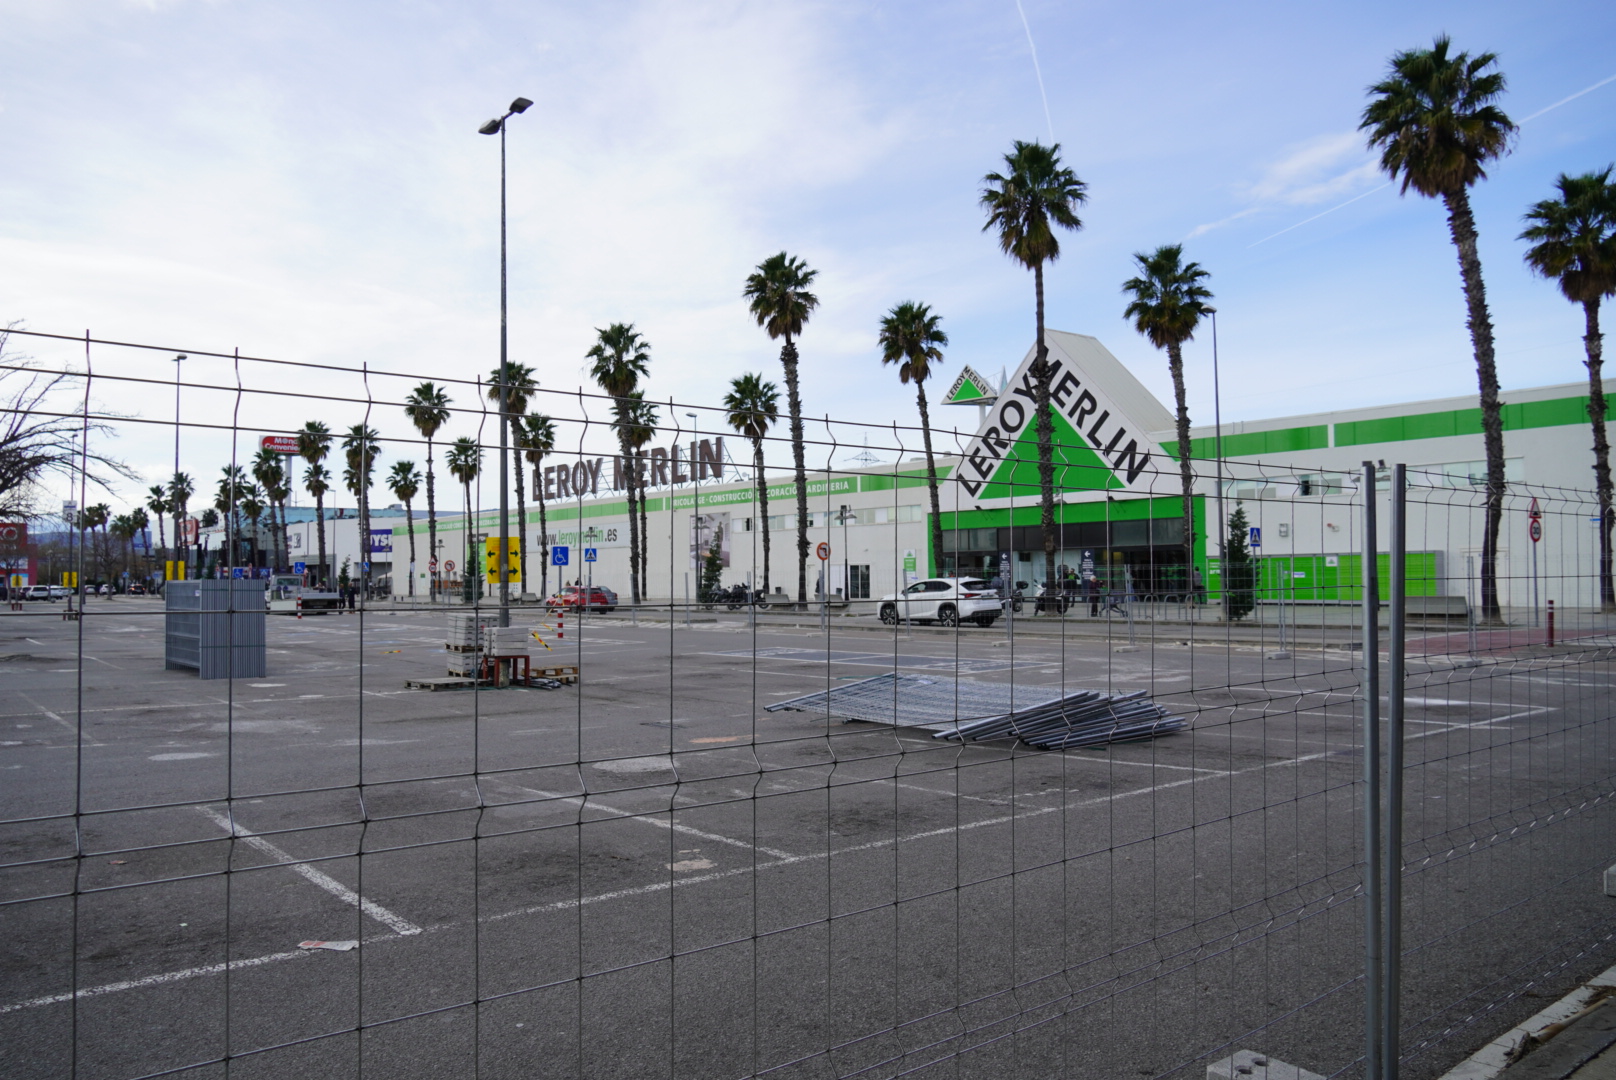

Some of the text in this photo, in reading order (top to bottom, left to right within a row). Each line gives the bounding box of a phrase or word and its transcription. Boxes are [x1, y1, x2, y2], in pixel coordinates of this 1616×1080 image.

[946, 365, 988, 400] LEROY MERLIN
[957, 372, 1039, 498] LEROY
[532, 457, 603, 501] LEROY
[671, 495, 705, 507] RICOLAGE
[66, 512, 73, 522] 8
[1532, 526, 1540, 535] 30
